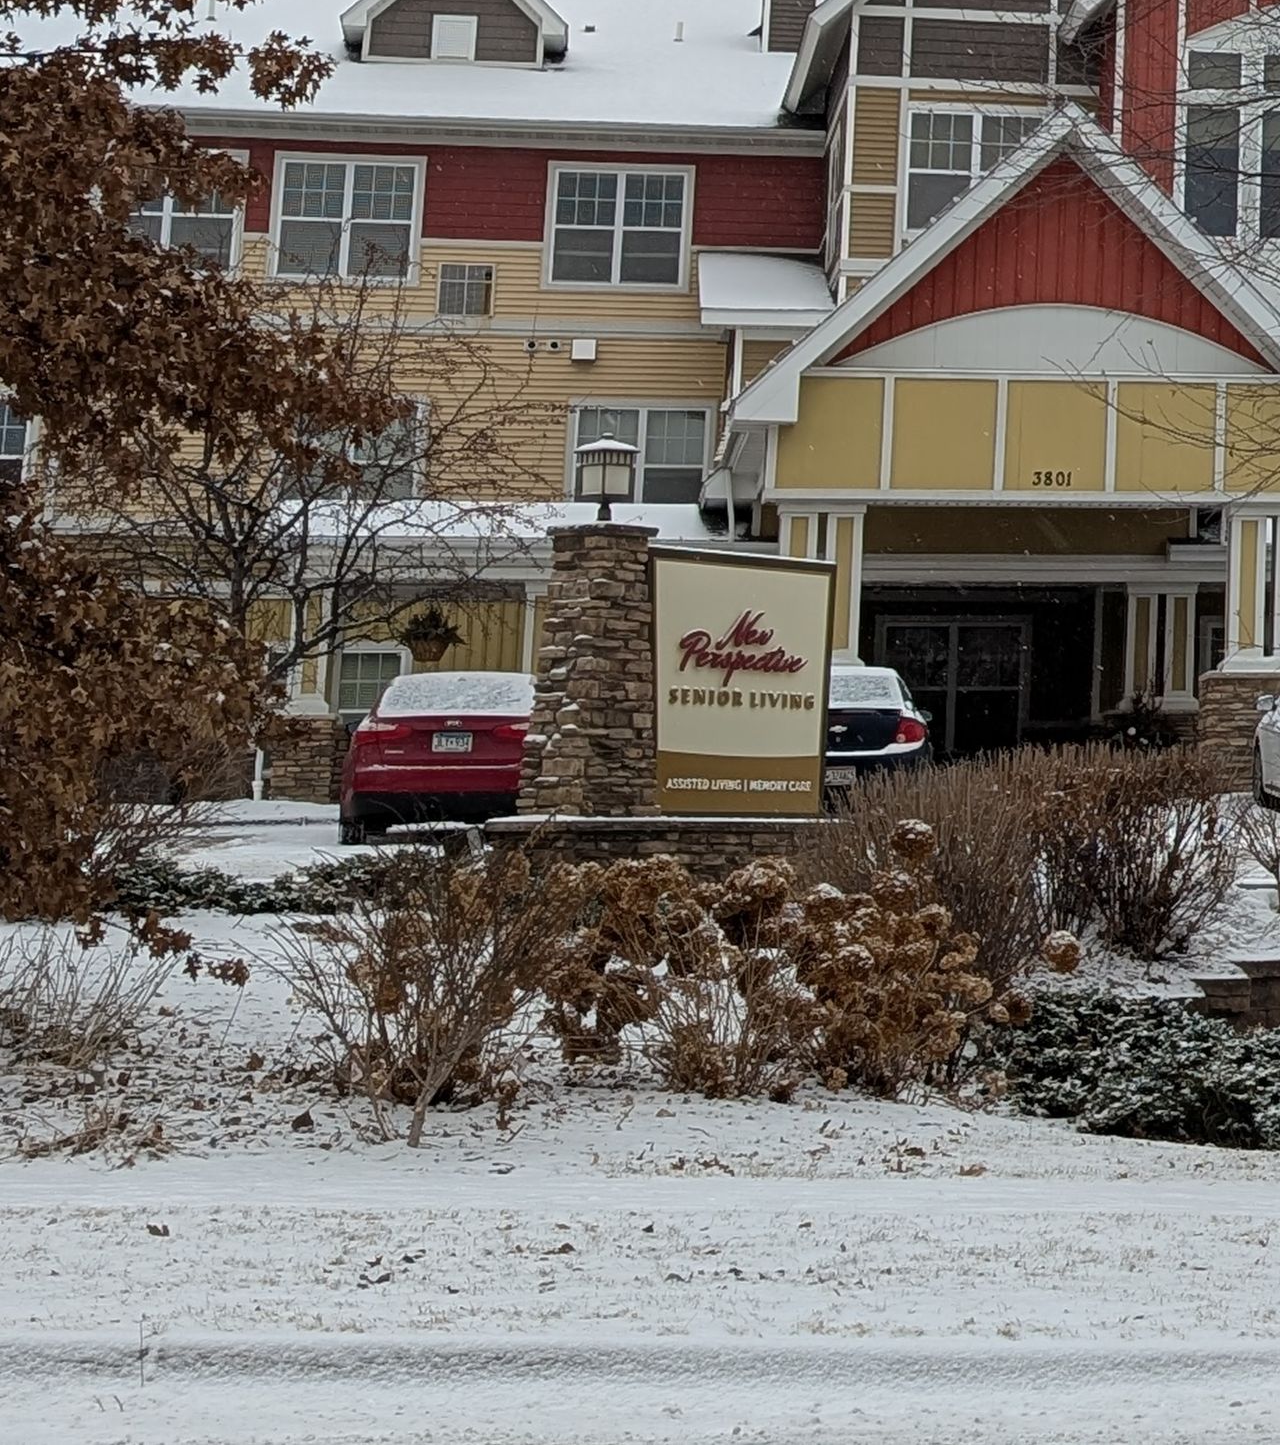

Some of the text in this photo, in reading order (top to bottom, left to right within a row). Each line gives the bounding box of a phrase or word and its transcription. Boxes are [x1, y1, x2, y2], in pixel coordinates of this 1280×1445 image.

[1032, 471, 1072, 487] 3801
[715, 609, 774, 650] New
[679, 629, 808, 687] Perspective
[668, 688, 814, 710] SENIOR LIVING
[666, 778, 812, 791] ASSISTED LIVING MEMORY CARE
